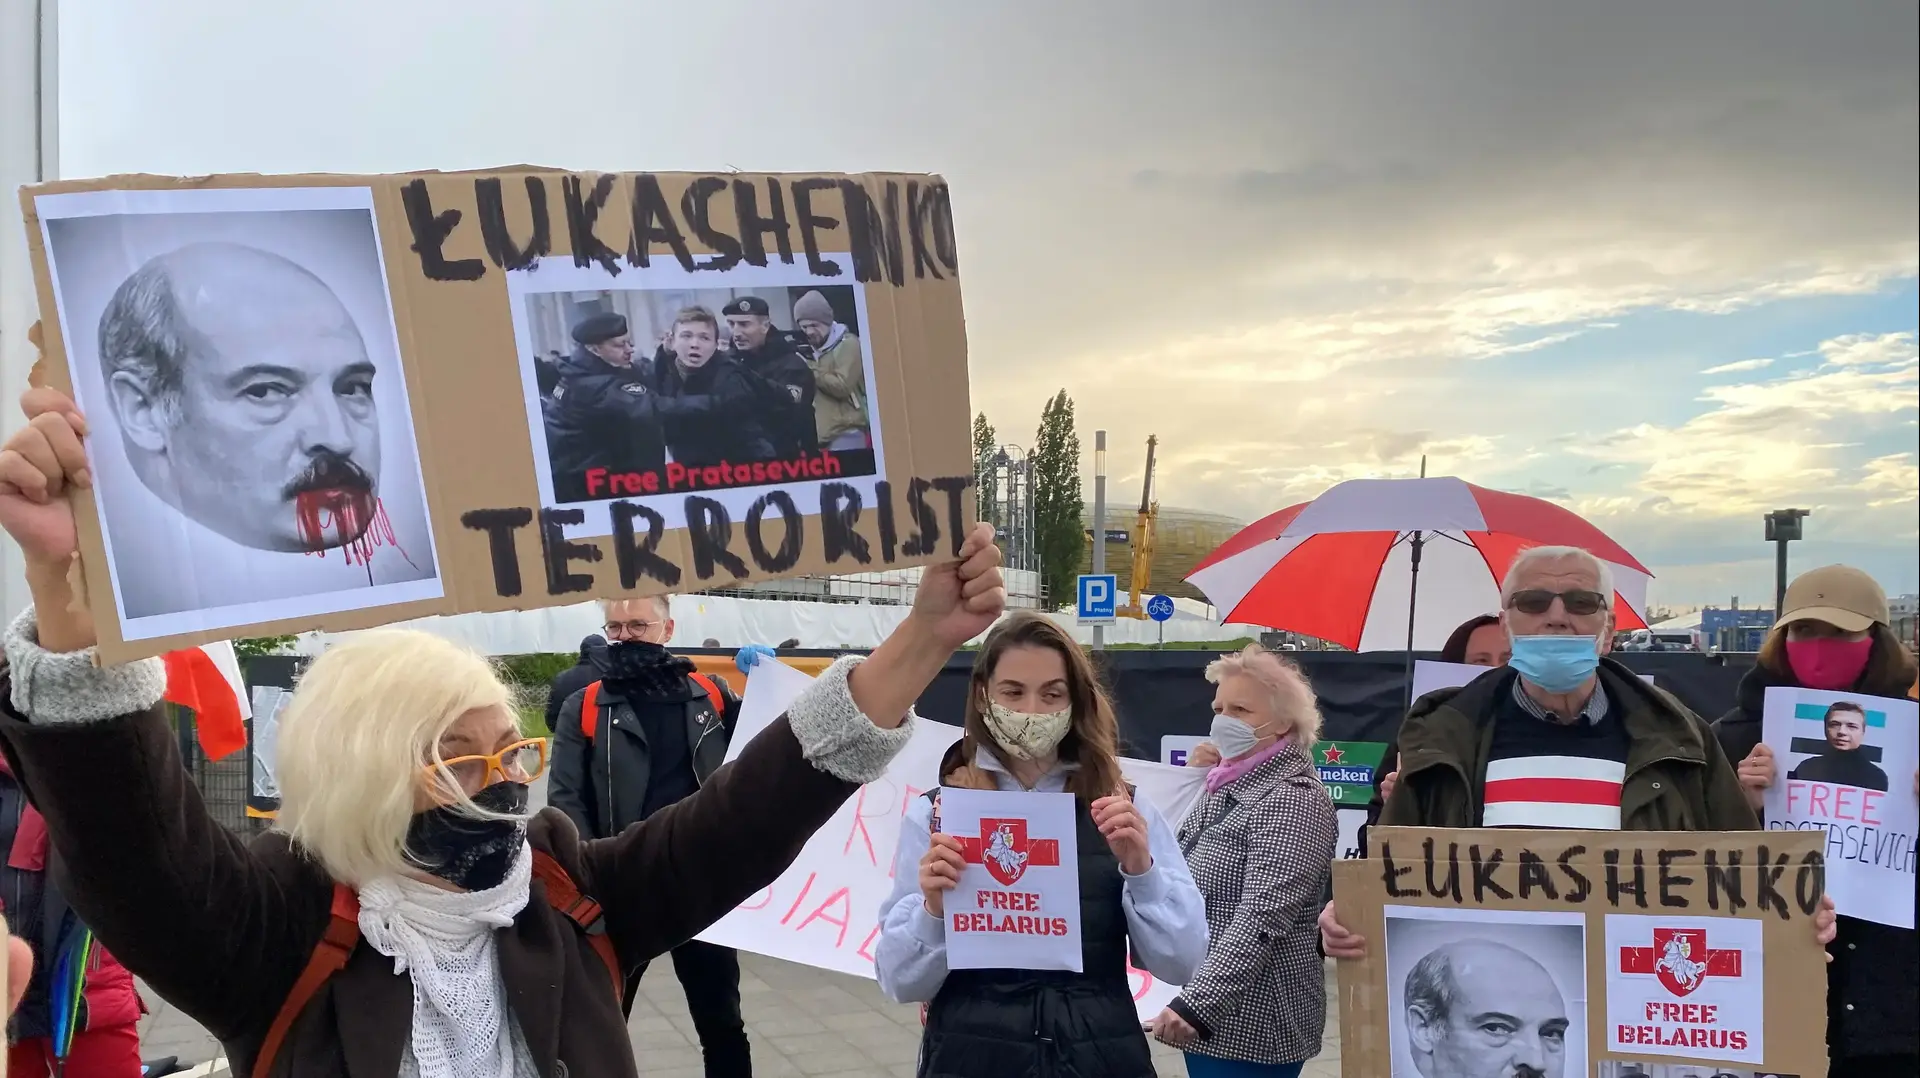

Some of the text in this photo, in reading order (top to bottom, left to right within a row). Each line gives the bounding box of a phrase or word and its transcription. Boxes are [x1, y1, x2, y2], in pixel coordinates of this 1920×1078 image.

[402, 174, 957, 287] ŁUKASHENKO
[585, 448, 841, 496] Free Pratasevich
[461, 475, 973, 596] TERRORIST
[1086, 580, 1107, 612] P
[1316, 767, 1370, 782] ineken
[1787, 782, 1886, 825] FREE
[1381, 837, 1825, 920] ŁUKASHENKO
[977, 890, 1040, 912] FREE
[953, 913, 1068, 936] BELARUS
[1645, 1002, 1718, 1024] FREE
[1618, 1024, 1748, 1050] BELARUS
